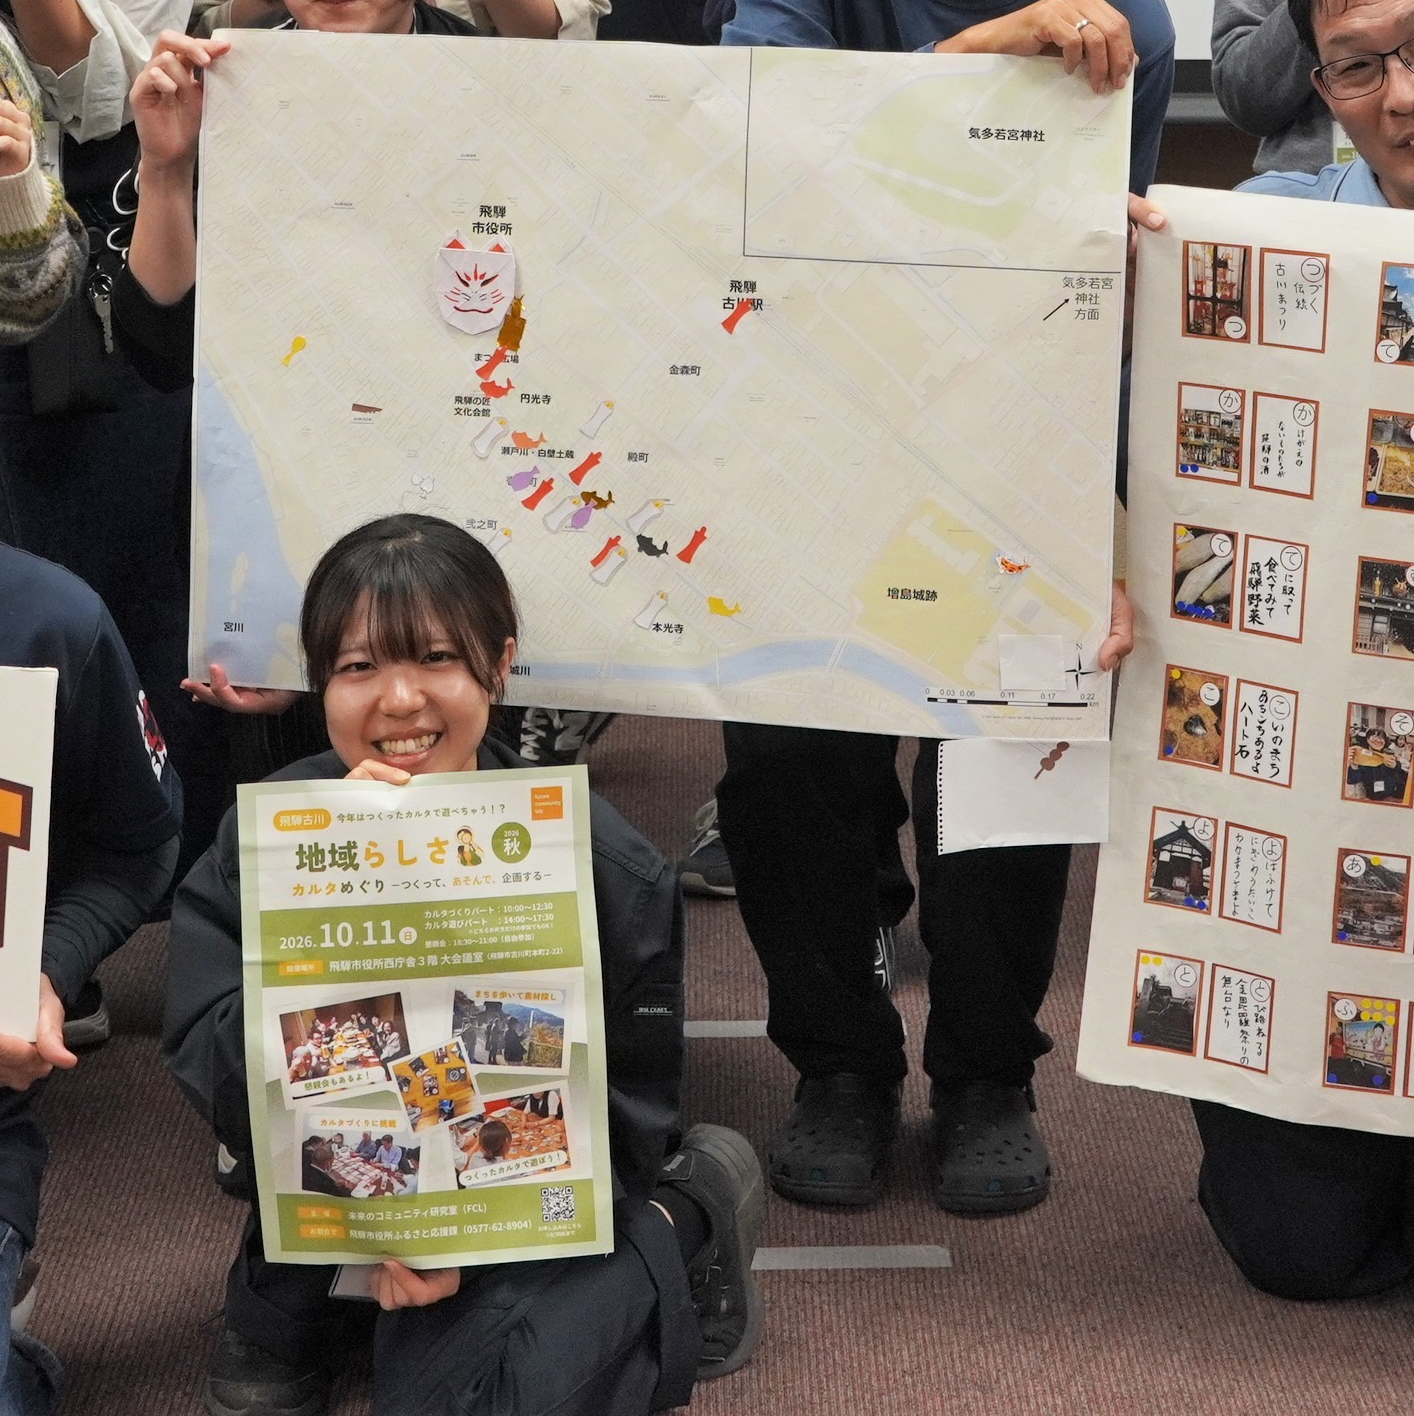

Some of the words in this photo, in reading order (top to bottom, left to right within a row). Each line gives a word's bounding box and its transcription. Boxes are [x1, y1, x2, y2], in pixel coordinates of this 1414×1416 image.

[968, 127, 1045, 142] 気多若宮神社
[479, 205, 506, 218] 飛騨
[472, 222, 512, 235] 市役所
[730, 280, 757, 293] 飛騨
[1062, 276, 1114, 290] 気多若宮
[1075, 292, 1100, 305] 神社
[1275, 263, 1287, 332] 古川まつり
[1074, 308, 1099, 321] 方面
[1229, 321, 1242, 333] つ
[669, 365, 701, 376] 金森町
[454, 396, 491, 406] 飛騨の匠
[520, 394, 551, 405] 円光寺
[454, 408, 491, 417] 文化会館
[501, 446, 574, 459] 瀬戸川・白壁土蔵
[627, 453, 649, 463] 殿町
[466, 520, 497, 530] 弐之町
[1264, 556, 1279, 619] 食べてみて
[886, 586, 939, 603] 増島城跡
[223, 621, 245, 633] 宮川
[651, 622, 685, 635] 本光寺
[1001, 691, 1015, 699] 0.11
[1234, 701, 1253, 760] ハート石
[279, 814, 325, 826] 飛騨古川
[503, 837, 521, 856] 秋
[296, 837, 449, 872] 地域らしさ
[292, 880, 385, 896] カルタめぐり
[440, 952, 484, 966] 大会議室
[320, 1119, 396, 1129] カルタづくりに挑戦
